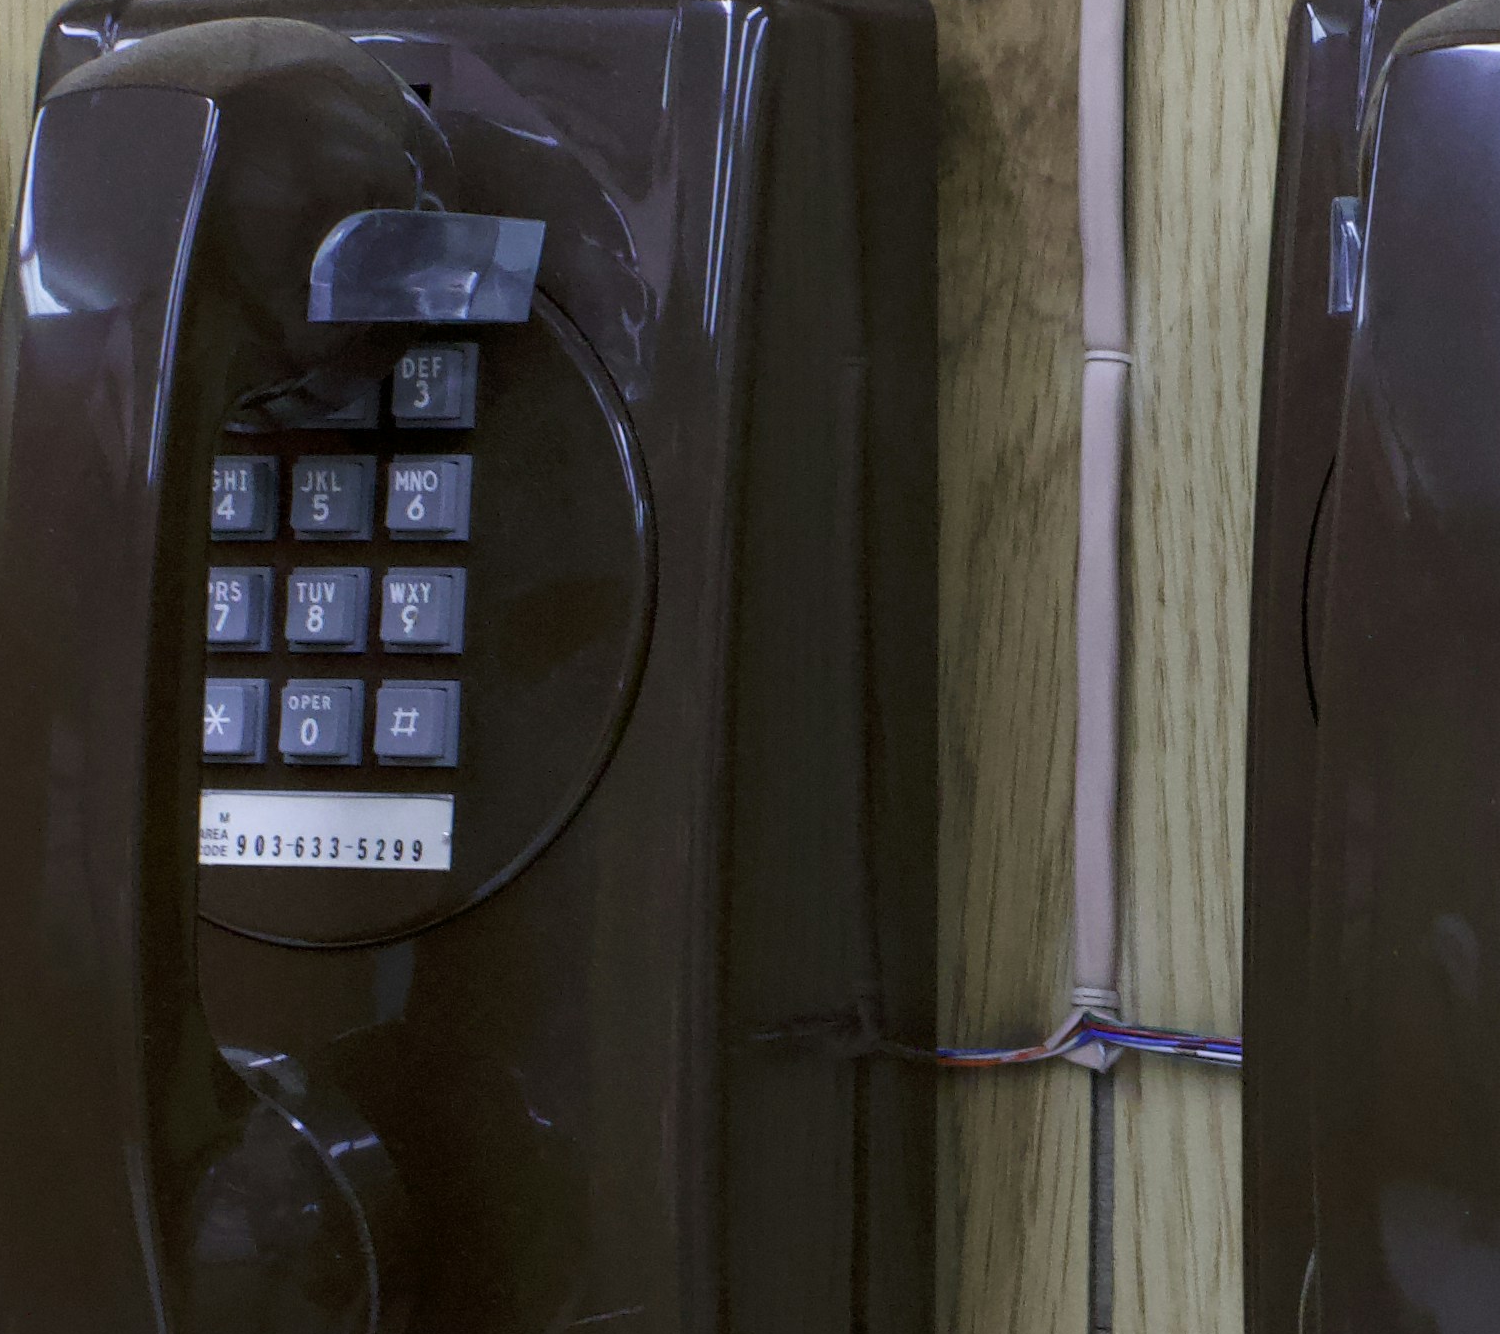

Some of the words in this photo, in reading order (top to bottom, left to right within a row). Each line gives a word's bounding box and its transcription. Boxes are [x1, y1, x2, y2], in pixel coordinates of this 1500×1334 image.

[401, 356, 444, 378] DEF
[413, 380, 432, 408] 3
[300, 471, 342, 492] JKL
[395, 470, 438, 491] MNO
[217, 496, 235, 520] 4
[312, 495, 330, 521] 5
[407, 495, 425, 521] 6
[296, 582, 335, 603] TUV
[390, 583, 431, 603] WXY
[214, 604, 230, 631] 7
[306, 605, 324, 633] 8
[401, 606, 418, 633] 9
[289, 695, 332, 710] OPER
[236, 834, 423, 862] 903-633-5299
